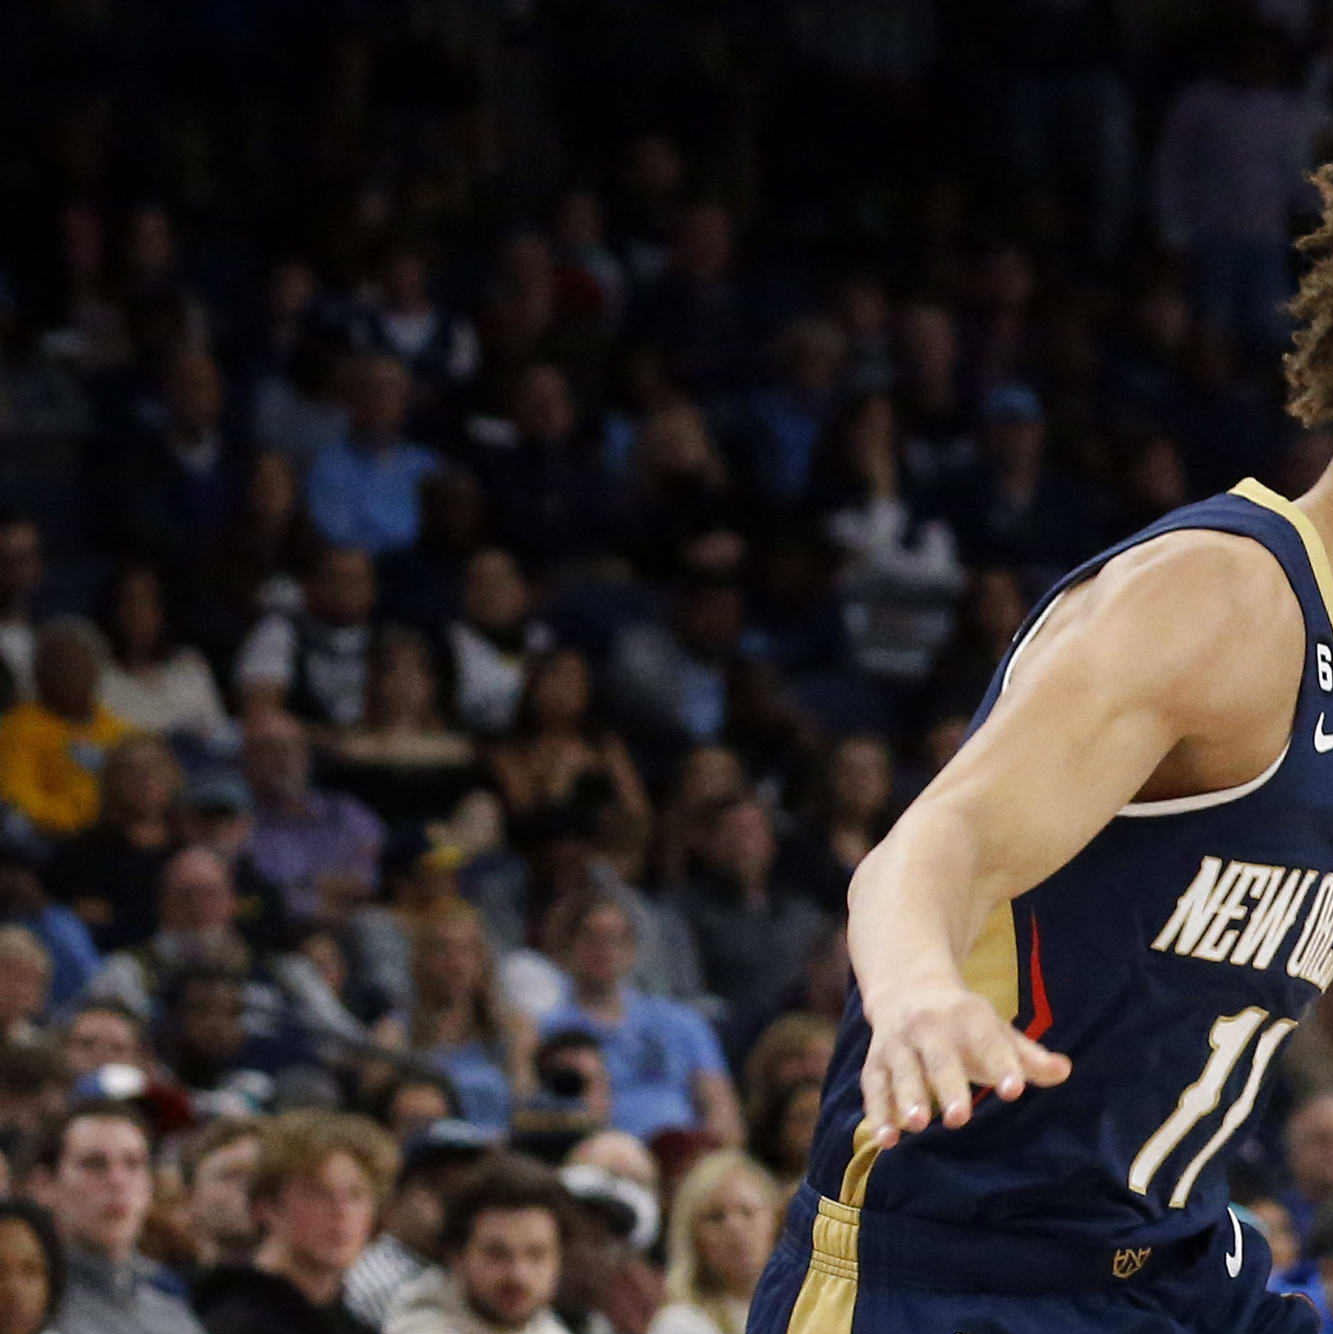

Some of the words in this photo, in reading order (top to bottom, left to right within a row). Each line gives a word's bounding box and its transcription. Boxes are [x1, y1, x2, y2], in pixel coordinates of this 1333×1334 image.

[1316, 643, 1333, 692] 6
[1150, 855, 1319, 970] NEW
[1128, 1005, 1299, 1209] 11
